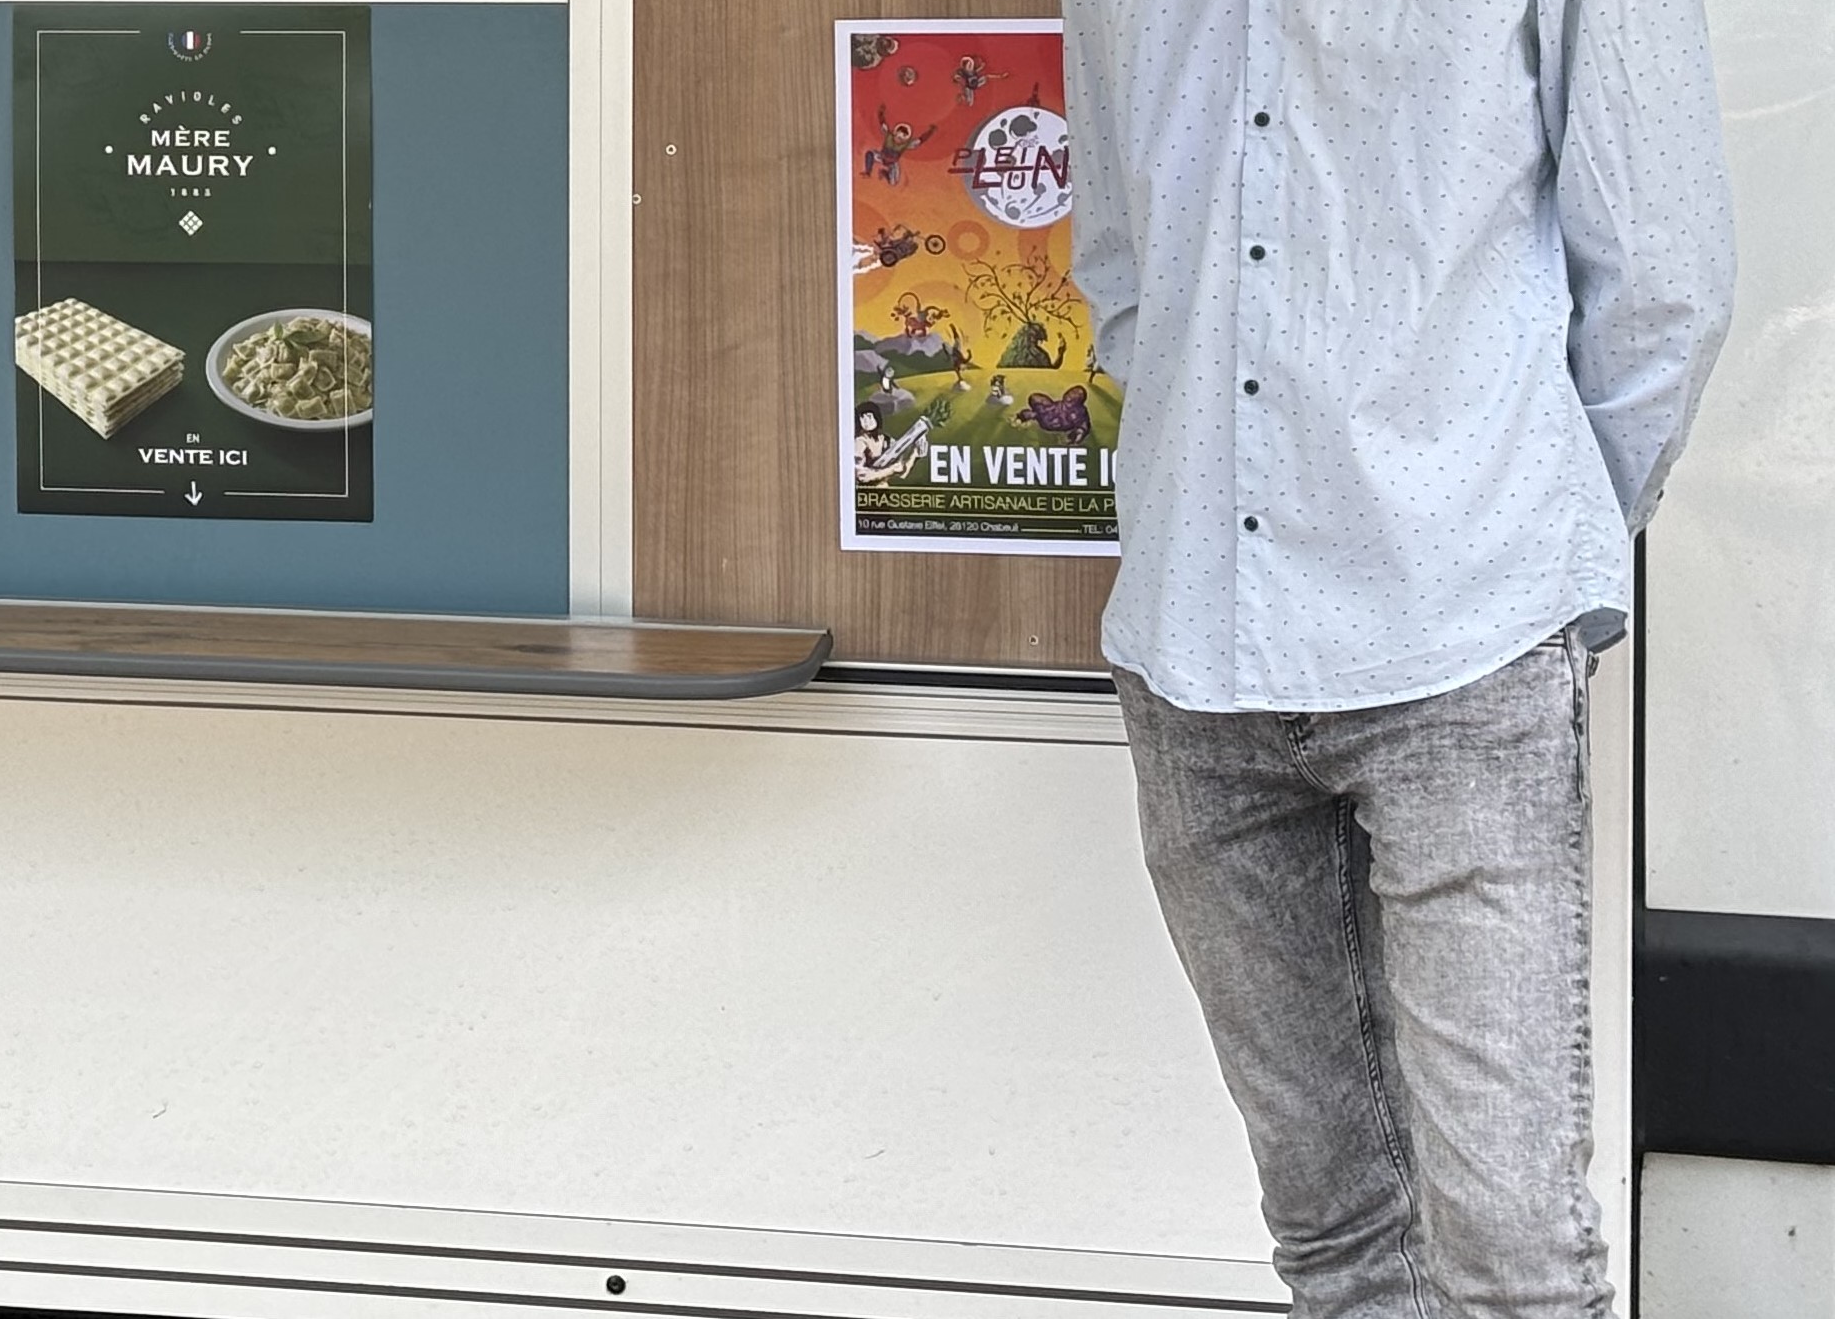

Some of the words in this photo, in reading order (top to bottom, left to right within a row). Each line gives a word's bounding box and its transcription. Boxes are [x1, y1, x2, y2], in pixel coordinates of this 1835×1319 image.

[138, 89, 243, 126] RAVIOLES
[150, 125, 232, 148] MÈRE
[126, 154, 255, 177] MAURY
[186, 432, 200, 444] EN
[138, 448, 214, 466] VENTE
[219, 449, 249, 466] ICI
[929, 444, 972, 484] EN
[982, 445, 1088, 487] VENTE
[857, 492, 946, 509] BRASSERIE
[949, 494, 1047, 511] ARTISANALE
[1051, 497, 1074, 512] DE
[1078, 498, 1099, 512] LA
[858, 519, 870, 529] 10
[871, 521, 885, 529] rue
[887, 519, 923, 530] Gustave
